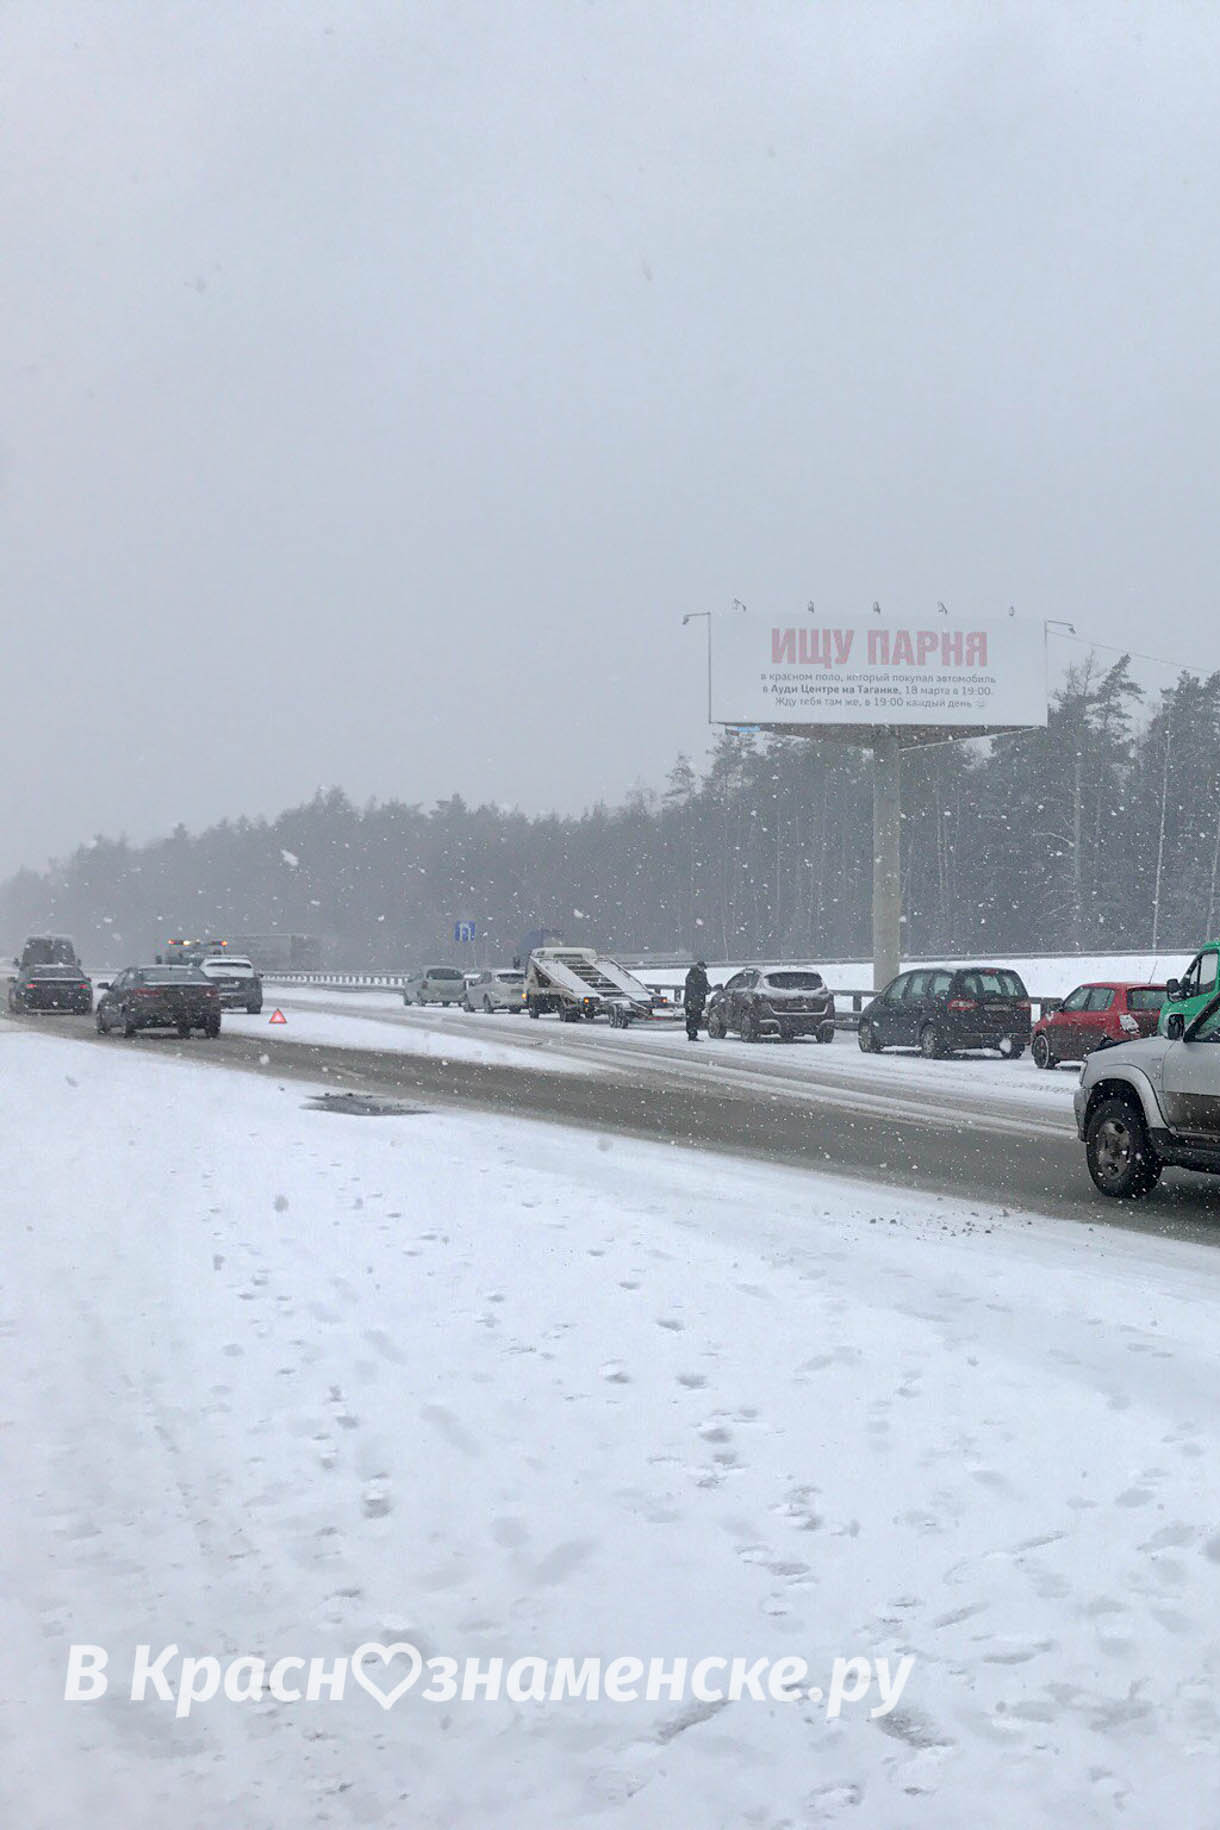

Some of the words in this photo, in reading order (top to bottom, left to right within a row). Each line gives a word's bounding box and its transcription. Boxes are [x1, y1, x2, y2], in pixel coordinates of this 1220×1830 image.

[771, 628, 854, 668] ИЩУ
[867, 630, 988, 667] ПАРНЯ
[769, 672, 813, 684] красном
[815, 672, 843, 682] поло,
[846, 672, 890, 685] который
[892, 674, 934, 685] покупал
[936, 674, 997, 684] автомобиль
[771, 684, 798, 695] Ауди
[801, 684, 840, 696] Центре
[842, 686, 855, 694] на
[858, 685, 902, 696] Таганке,
[905, 685, 919, 695] 18
[920, 686, 951, 697] марта
[952, 687, 959, 695] в
[775, 697, 797, 708] Жду
[799, 697, 822, 706] тебя
[824, 698, 842, 706] там
[845, 699, 862, 707] же,
[906, 698, 946, 709] каждый
[947, 700, 973, 709] день
